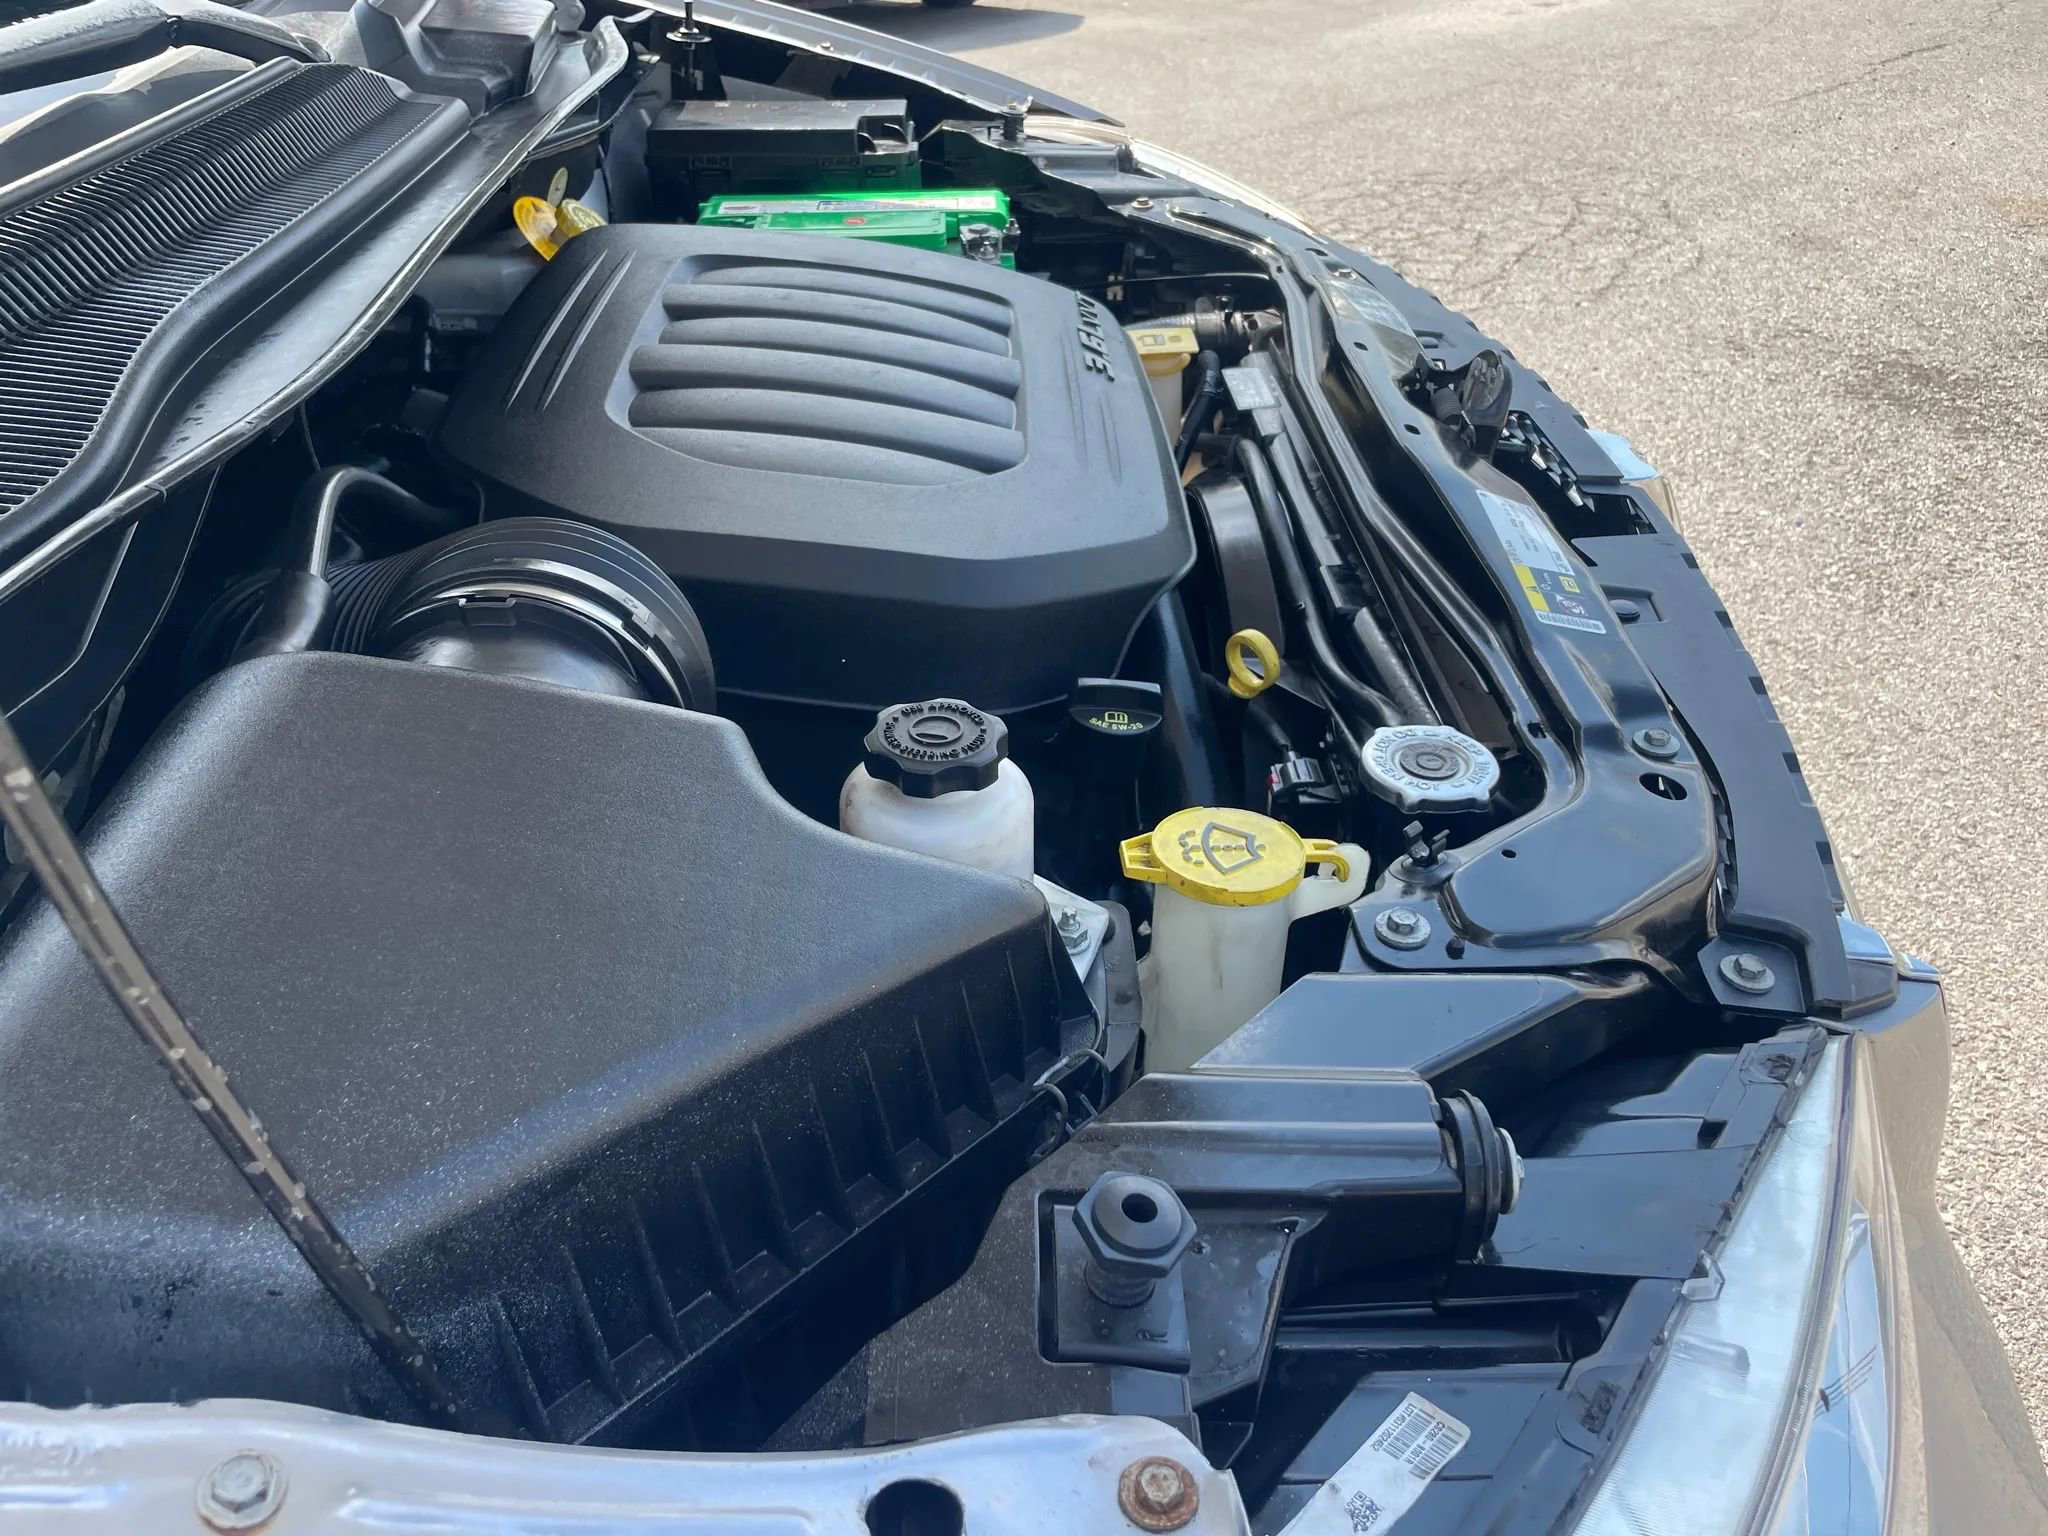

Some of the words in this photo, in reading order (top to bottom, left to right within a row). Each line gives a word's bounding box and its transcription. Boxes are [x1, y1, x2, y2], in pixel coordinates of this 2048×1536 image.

[928, 703, 986, 726] APPROVED
[1089, 717, 1110, 729] SAE
[1111, 722, 1144, 731] 5W-20
[883, 721, 902, 750] POWER
[900, 745, 961, 761] STEERING
